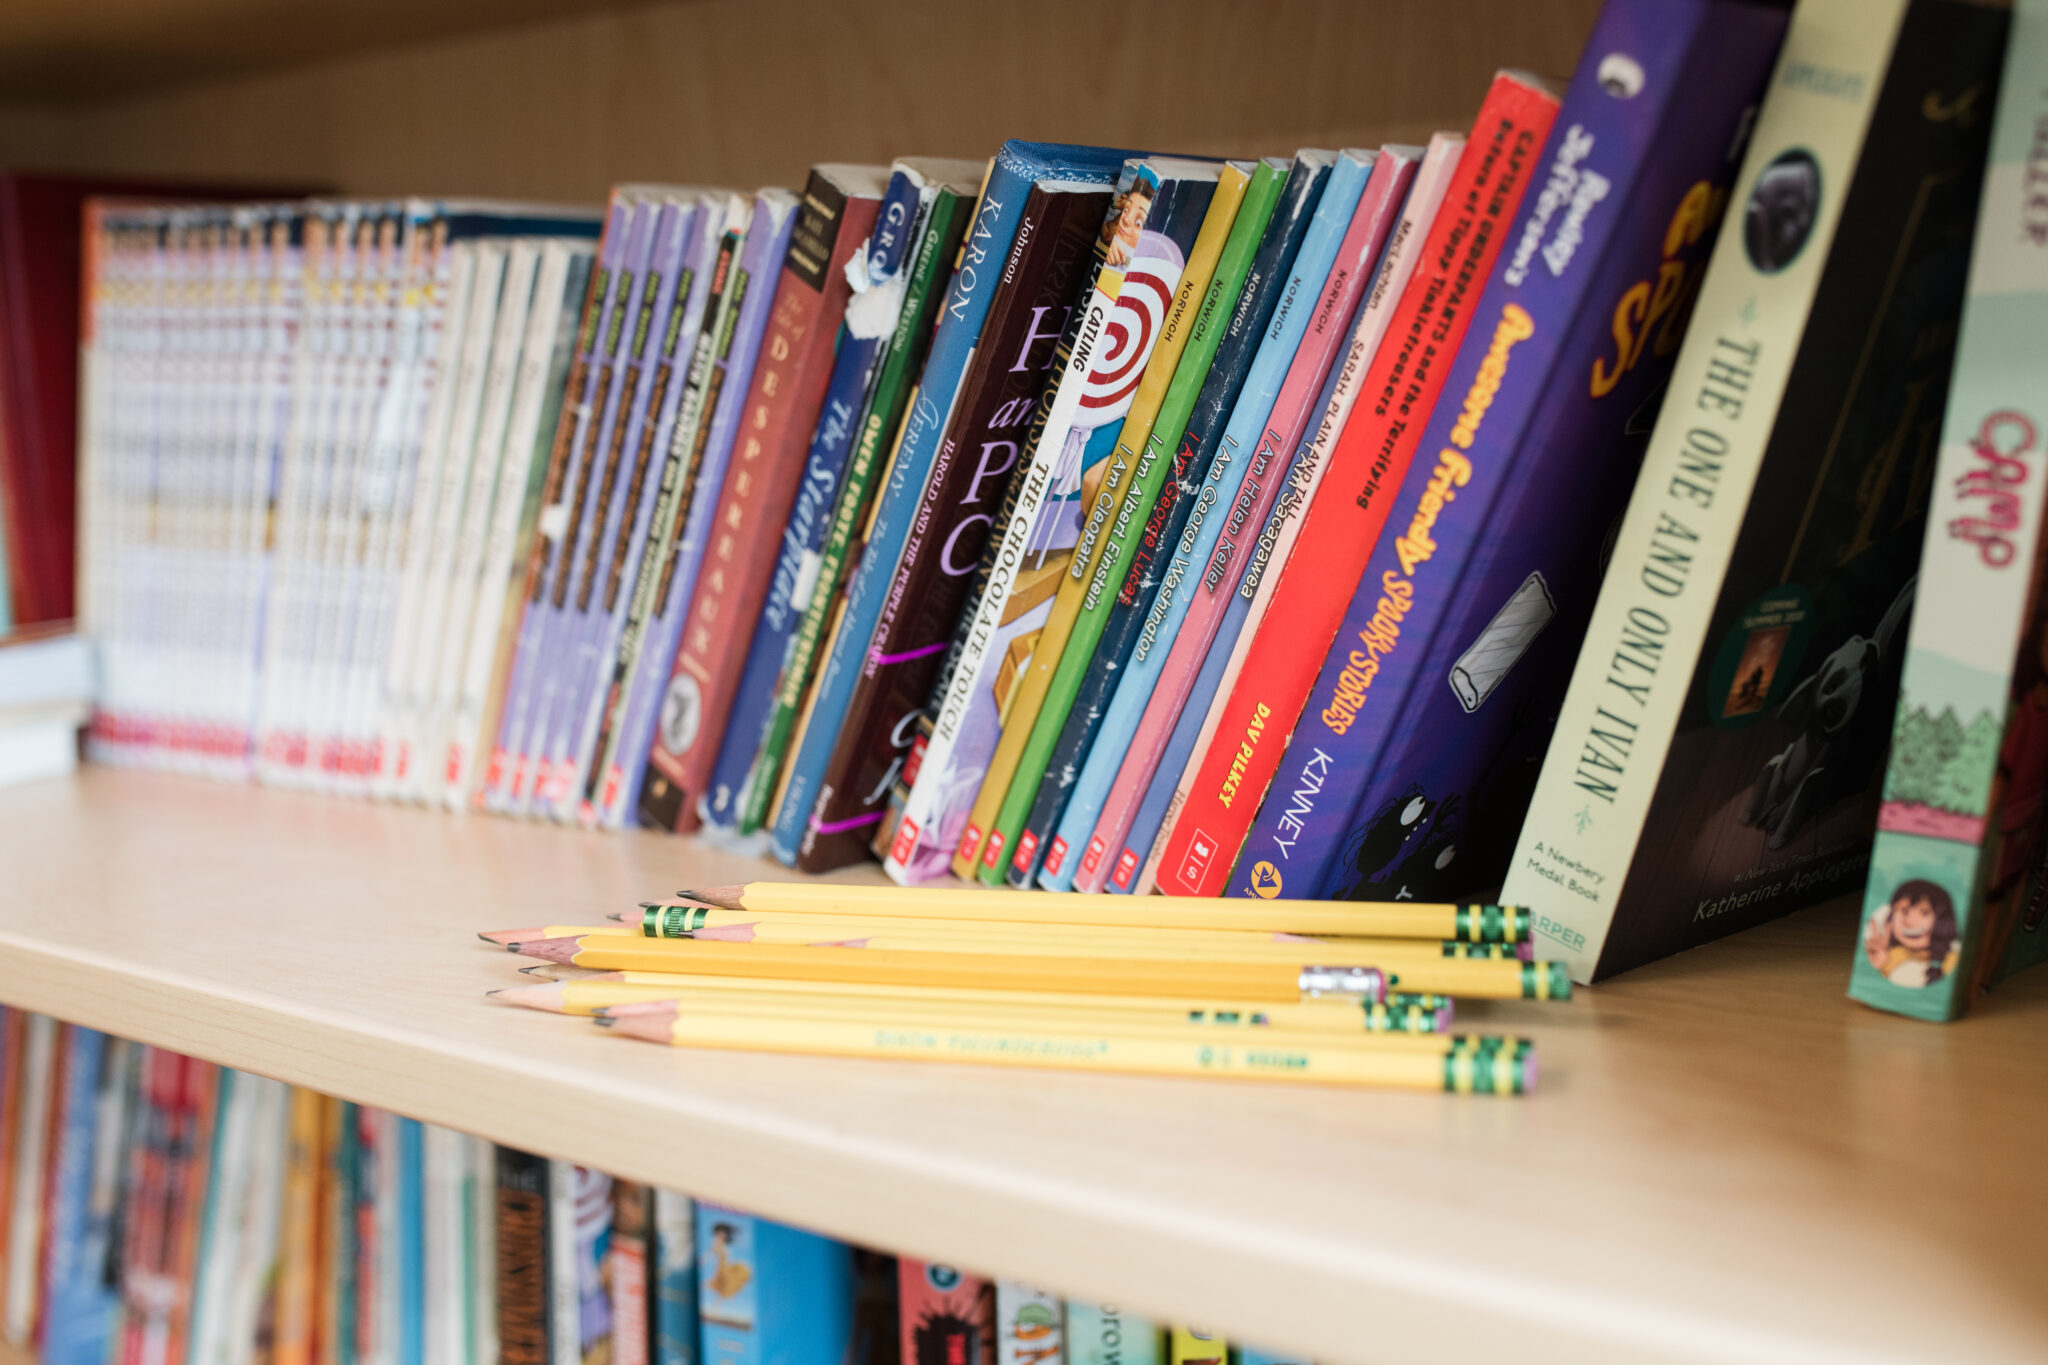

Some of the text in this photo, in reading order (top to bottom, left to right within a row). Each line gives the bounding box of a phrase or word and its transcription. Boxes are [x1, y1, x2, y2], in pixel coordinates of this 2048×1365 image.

[872, 201, 906, 267] GRO
[916, 229, 940, 282] GREENE
[949, 192, 1003, 323] KARON
[1003, 216, 1034, 285] Johnson
[1438, 215, 1473, 273] Tippy
[892, 297, 919, 352] WESTON
[1164, 280, 1194, 343] NORWICH
[1193, 279, 1224, 342] NORWICH
[1229, 272, 1262, 337] NORWICH
[1270, 276, 1302, 341] NORWICH
[1315, 269, 1348, 336] NORWICH
[1356, 130, 1533, 510] CAPTAIN UNDERPANTS and the Terrifying
[1074, 306, 1104, 372] CATLING
[1375, 276, 1446, 417] Tinkletrousers
[854, 413, 882, 477] OWEN
[987, 397, 1040, 429] an
[1288, 341, 1364, 519] SARAH, PLAIN AND TALL
[929, 437, 956, 501] HAROLD
[1022, 461, 1050, 514] THE
[915, 502, 933, 535] AND
[1071, 443, 1134, 579] I Am Cleopatra
[1084, 433, 1165, 612] I Am Albert Einstein
[1119, 431, 1201, 606] I Am George Lucas
[1205, 429, 1282, 595] I Am Helen Keller
[1321, 302, 1535, 736] Awesome Friendly SPOOKY STORIES
[904, 535, 923, 563] THE
[1135, 434, 1239, 663] I Am George Washington
[1240, 491, 1294, 599] Sacagawea
[1573, 335, 1763, 805] THE ONE AND ONLY IVAN
[886, 564, 911, 624] PURPLE
[968, 515, 1028, 662] CHOCOLATE
[940, 663, 975, 741] TOUCH
[1218, 701, 1271, 809] DAV PILKEY
[1273, 747, 1334, 859] KINNEY
[1527, 858, 1600, 904] Medal Book
[1534, 841, 1606, 885] A Newbery
[1531, 911, 1587, 949] ARPER
[1692, 881, 1783, 924] Katherine
